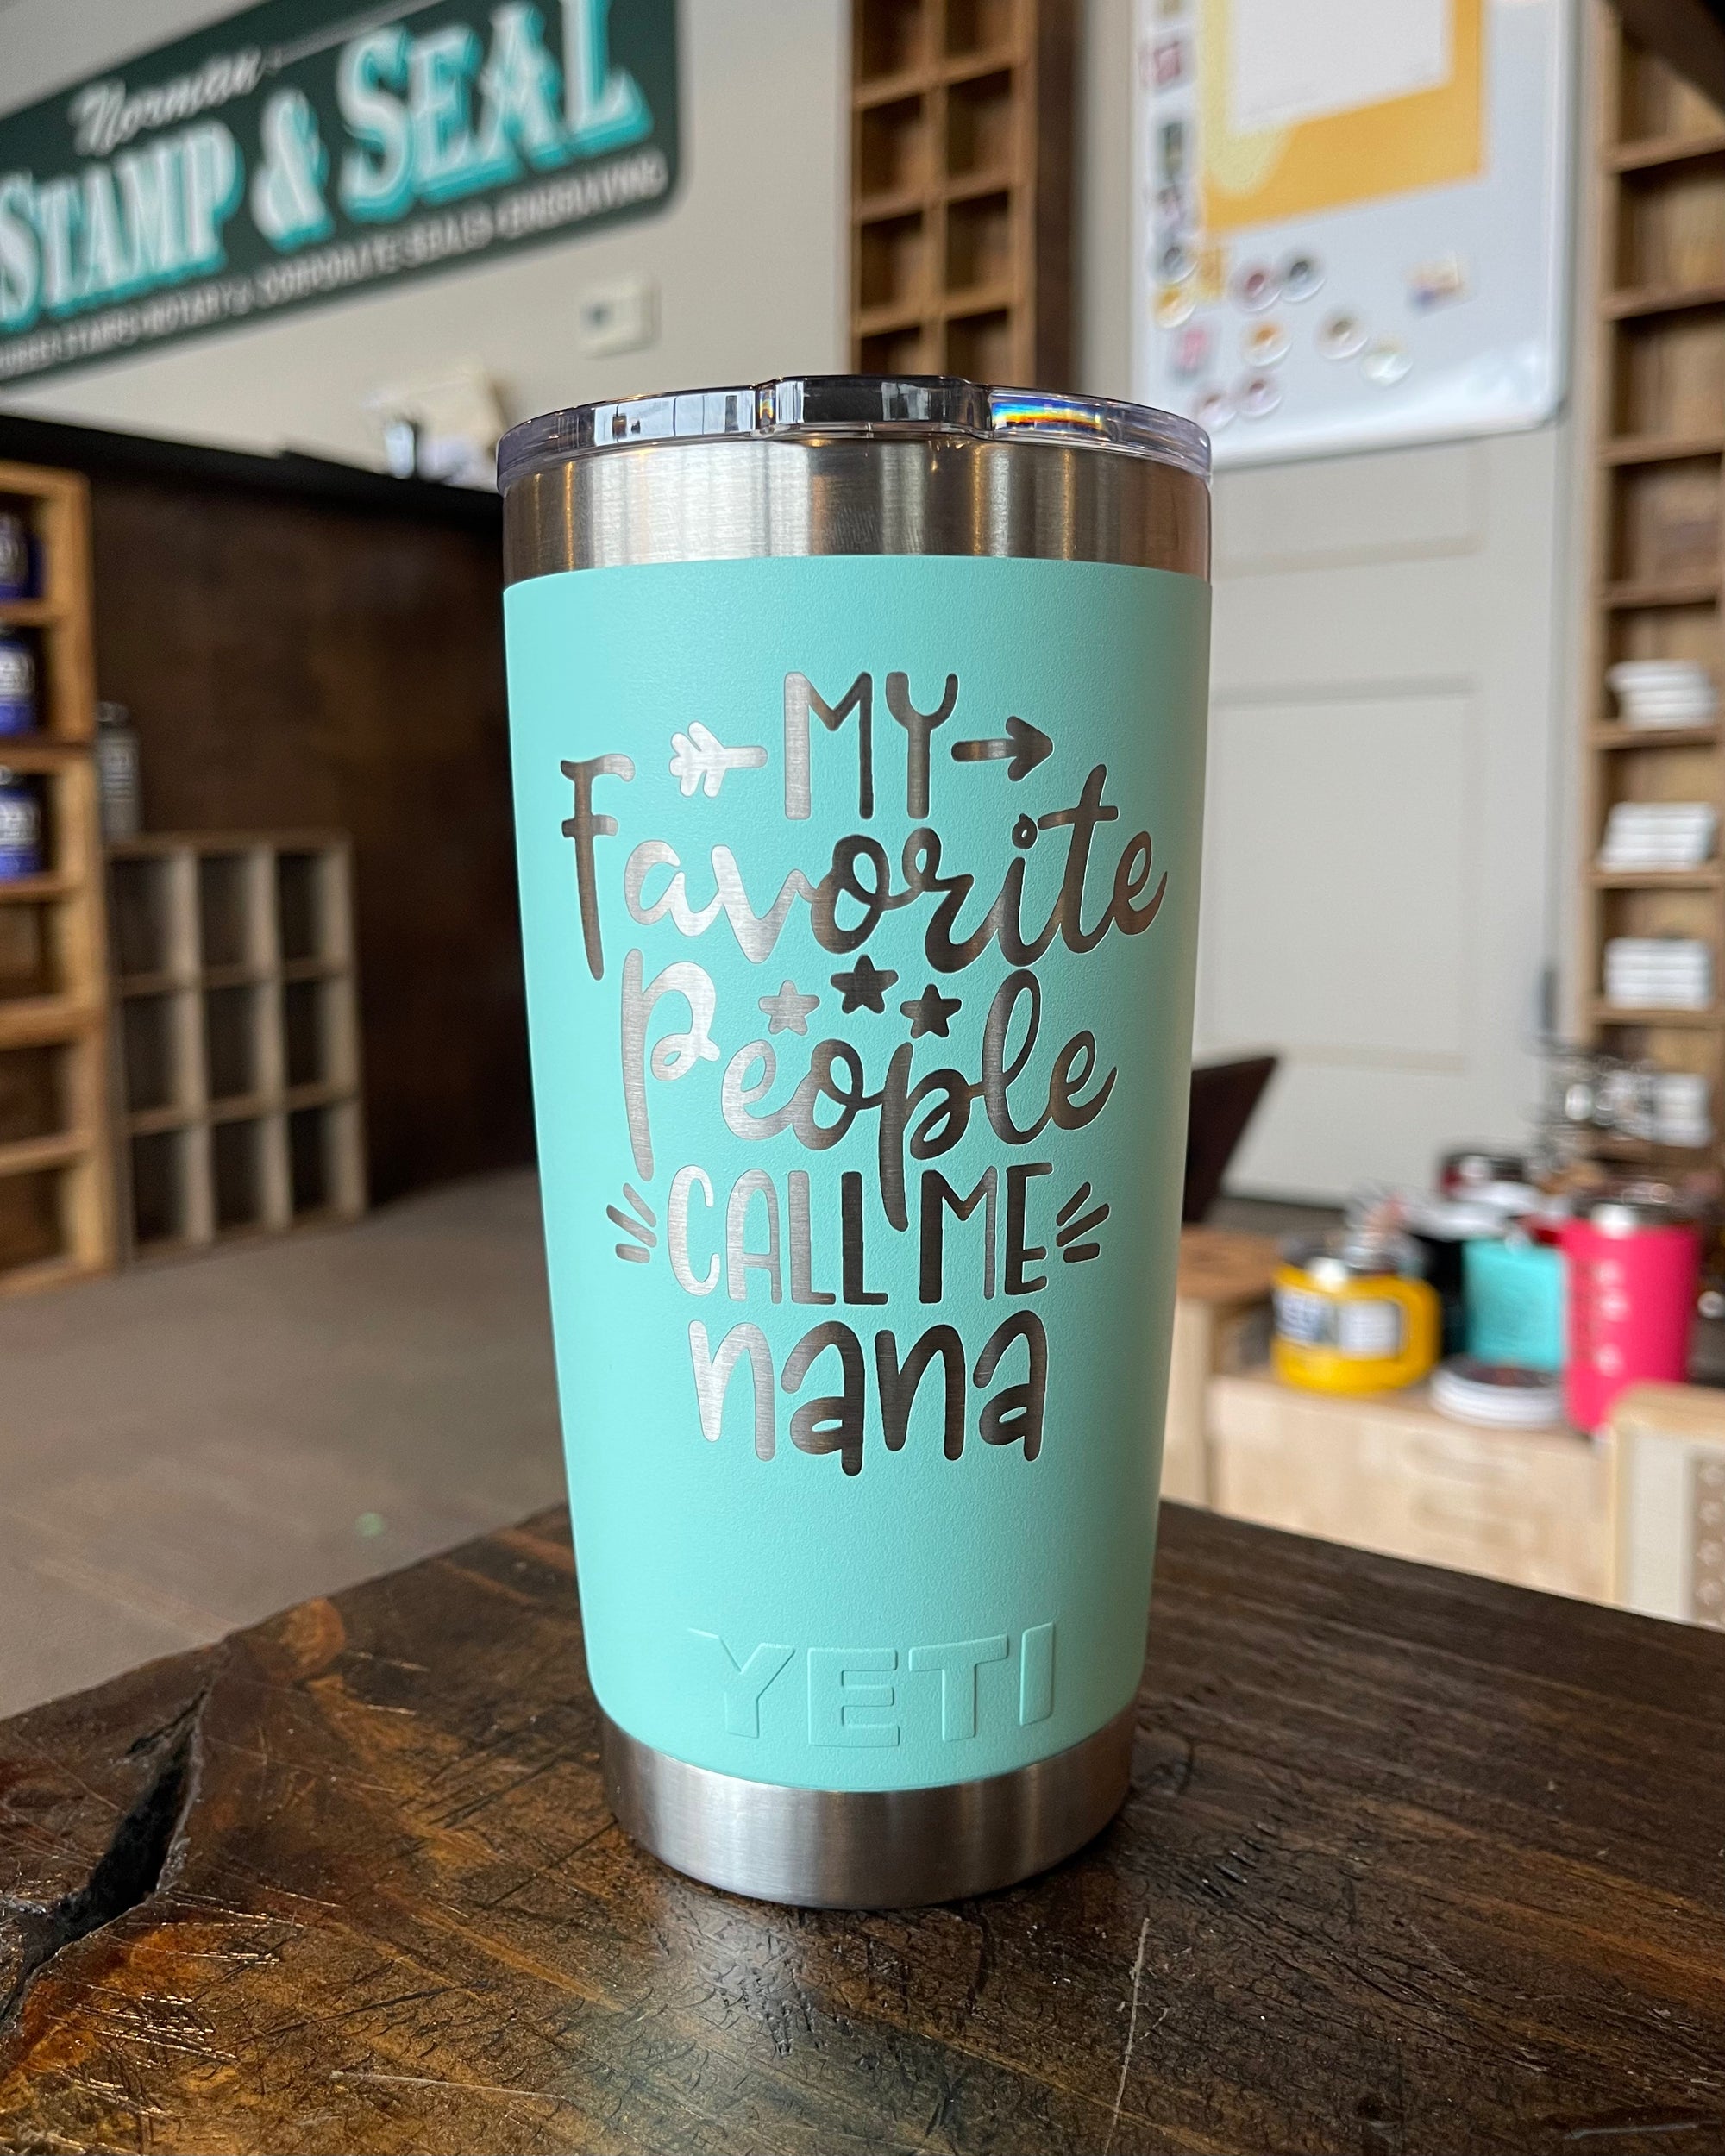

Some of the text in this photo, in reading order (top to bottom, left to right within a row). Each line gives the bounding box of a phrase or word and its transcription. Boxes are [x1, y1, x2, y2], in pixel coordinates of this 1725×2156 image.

[0, 0, 654, 333] STAMP & SEAL
[69, 47, 264, 156] Norman
[785, 672, 958, 819] MY
[561, 754, 1168, 981] Favorite
[621, 949, 1119, 1232] People
[668, 1162, 1054, 1305] CALL ME
[689, 1309, 1050, 1476] nana
[688, 1621, 1055, 1748] YETI
